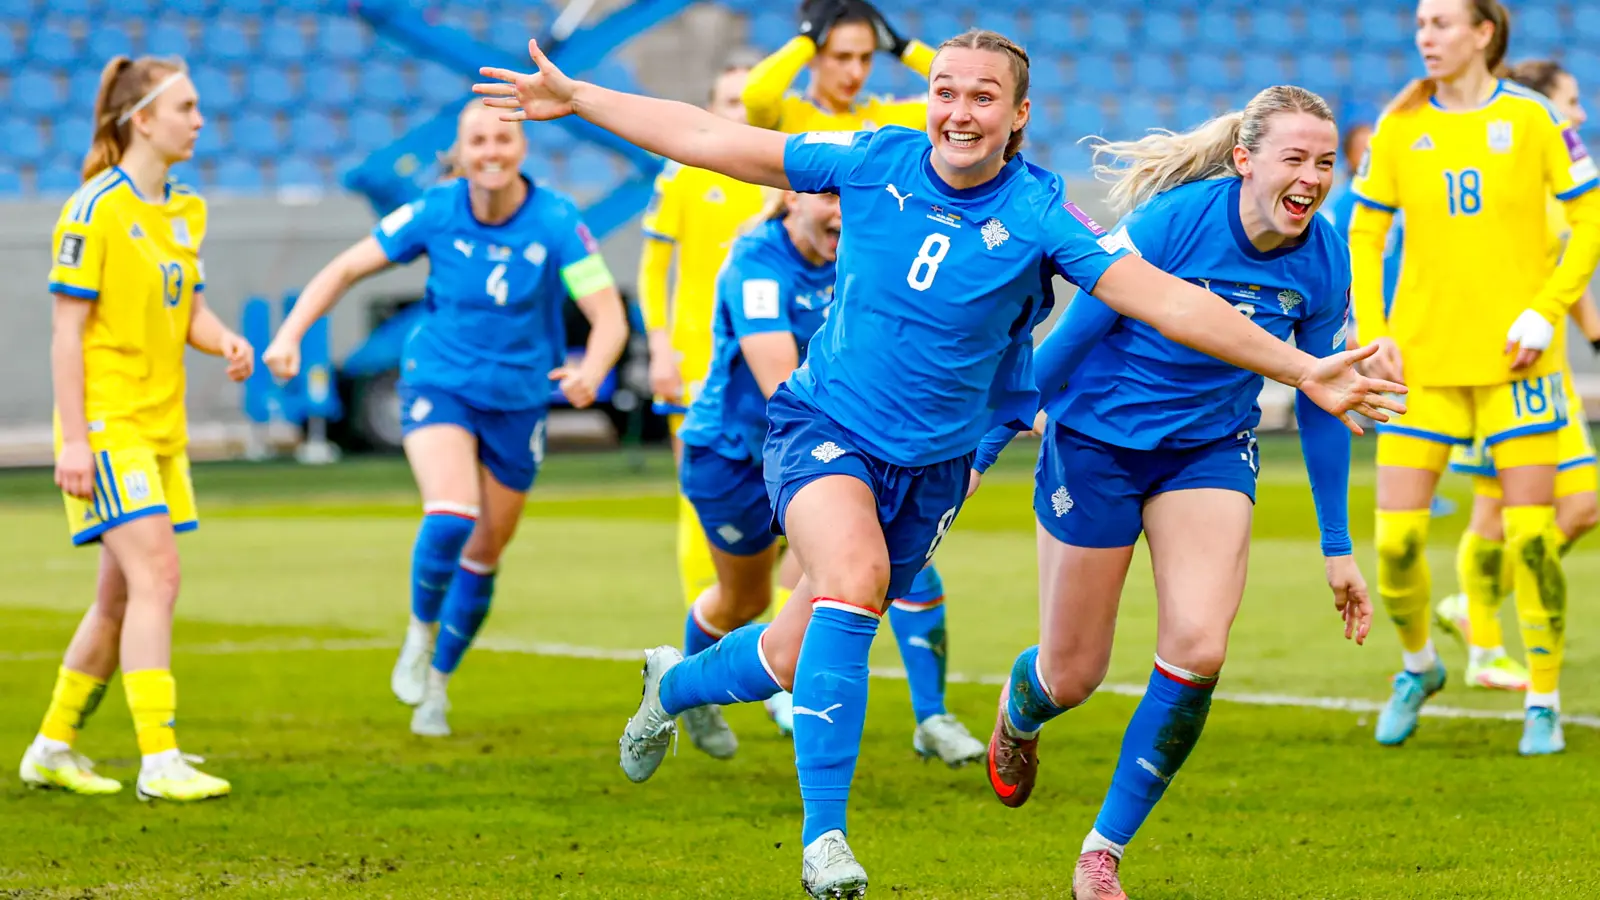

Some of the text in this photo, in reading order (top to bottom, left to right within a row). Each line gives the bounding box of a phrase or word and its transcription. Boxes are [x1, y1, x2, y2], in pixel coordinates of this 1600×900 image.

[1444, 169, 1481, 216] 18
[159, 262, 183, 307] 13
[486, 263, 508, 306] 4
[906, 232, 951, 292] 8
[1511, 376, 1547, 418] 18
[925, 505, 957, 560] 8
